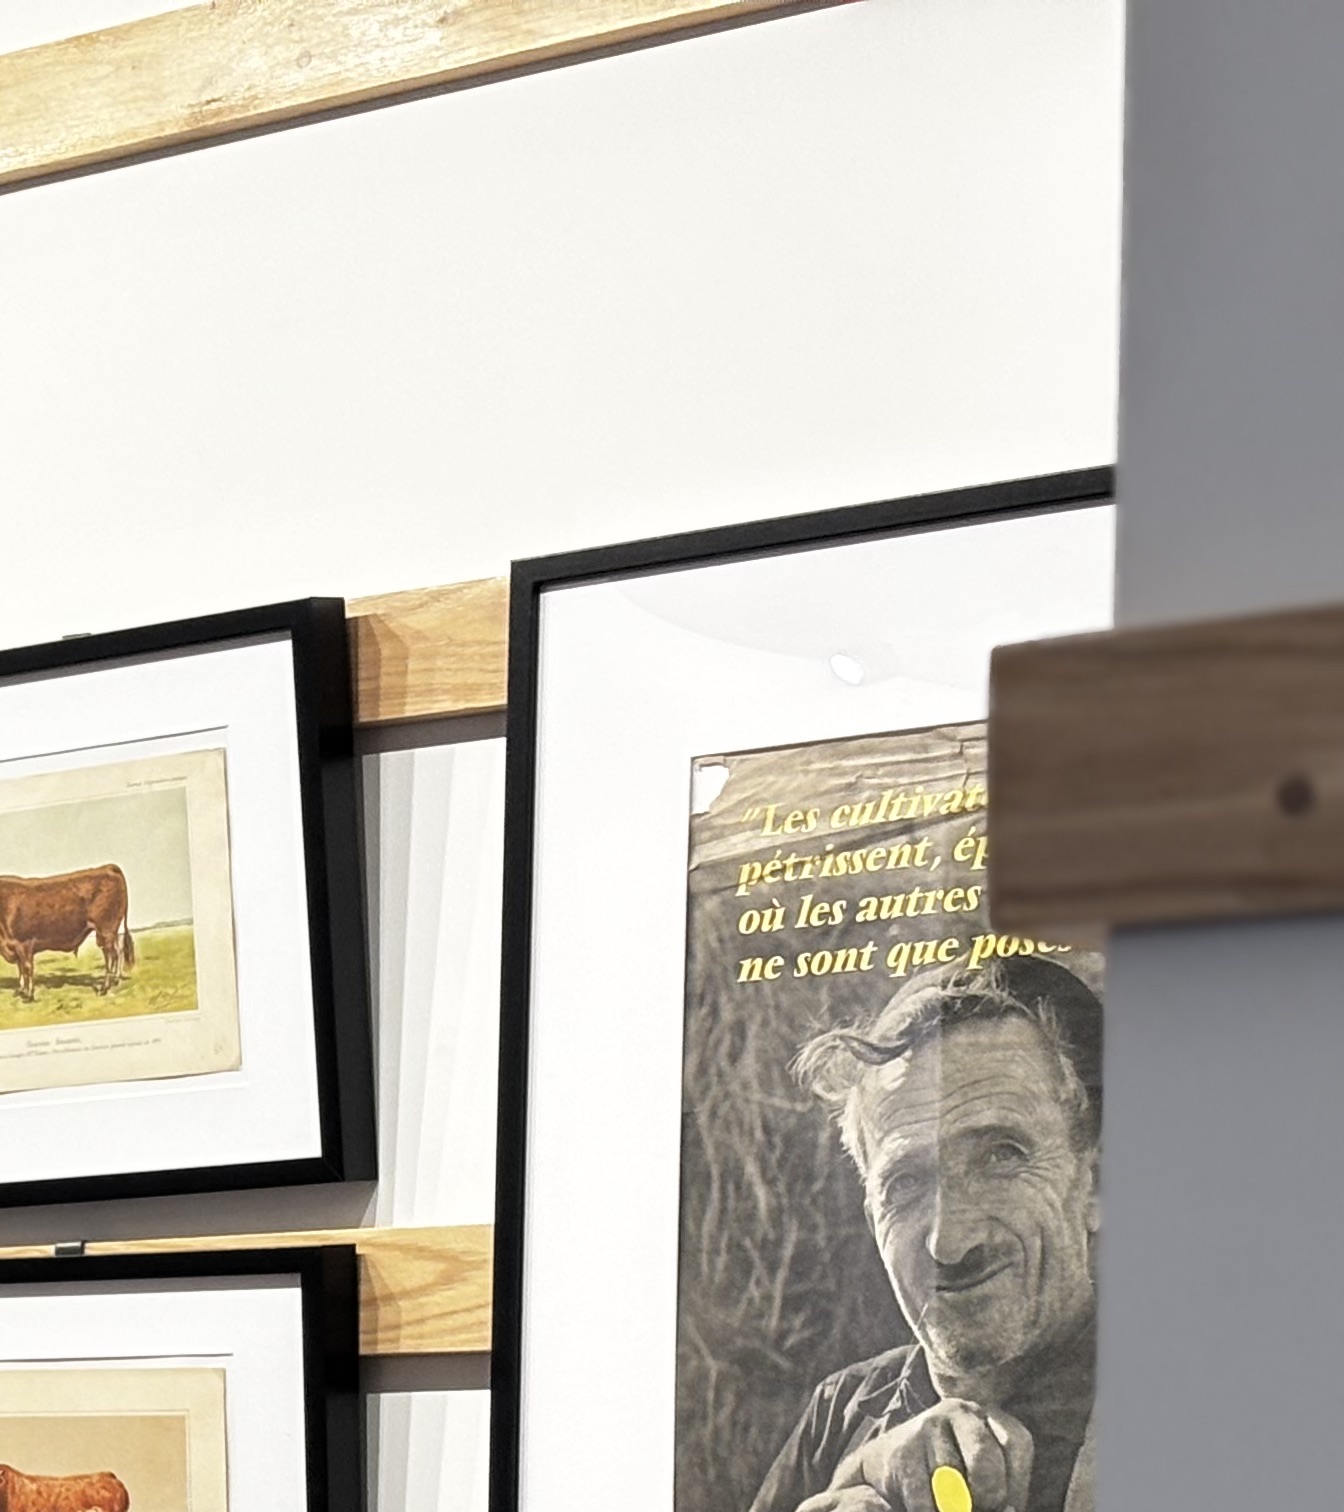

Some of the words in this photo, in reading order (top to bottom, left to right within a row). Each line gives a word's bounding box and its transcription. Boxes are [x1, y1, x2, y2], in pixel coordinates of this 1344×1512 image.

[735, 835, 941, 897] pétrissent,
[738, 897, 785, 935] où
[795, 894, 847, 929] les
[855, 885, 983, 923] autres
[736, 954, 784, 984] ne
[793, 939, 877, 977] sont
[886, 936, 960, 978] que
[965, 932, 1072, 971] pos
